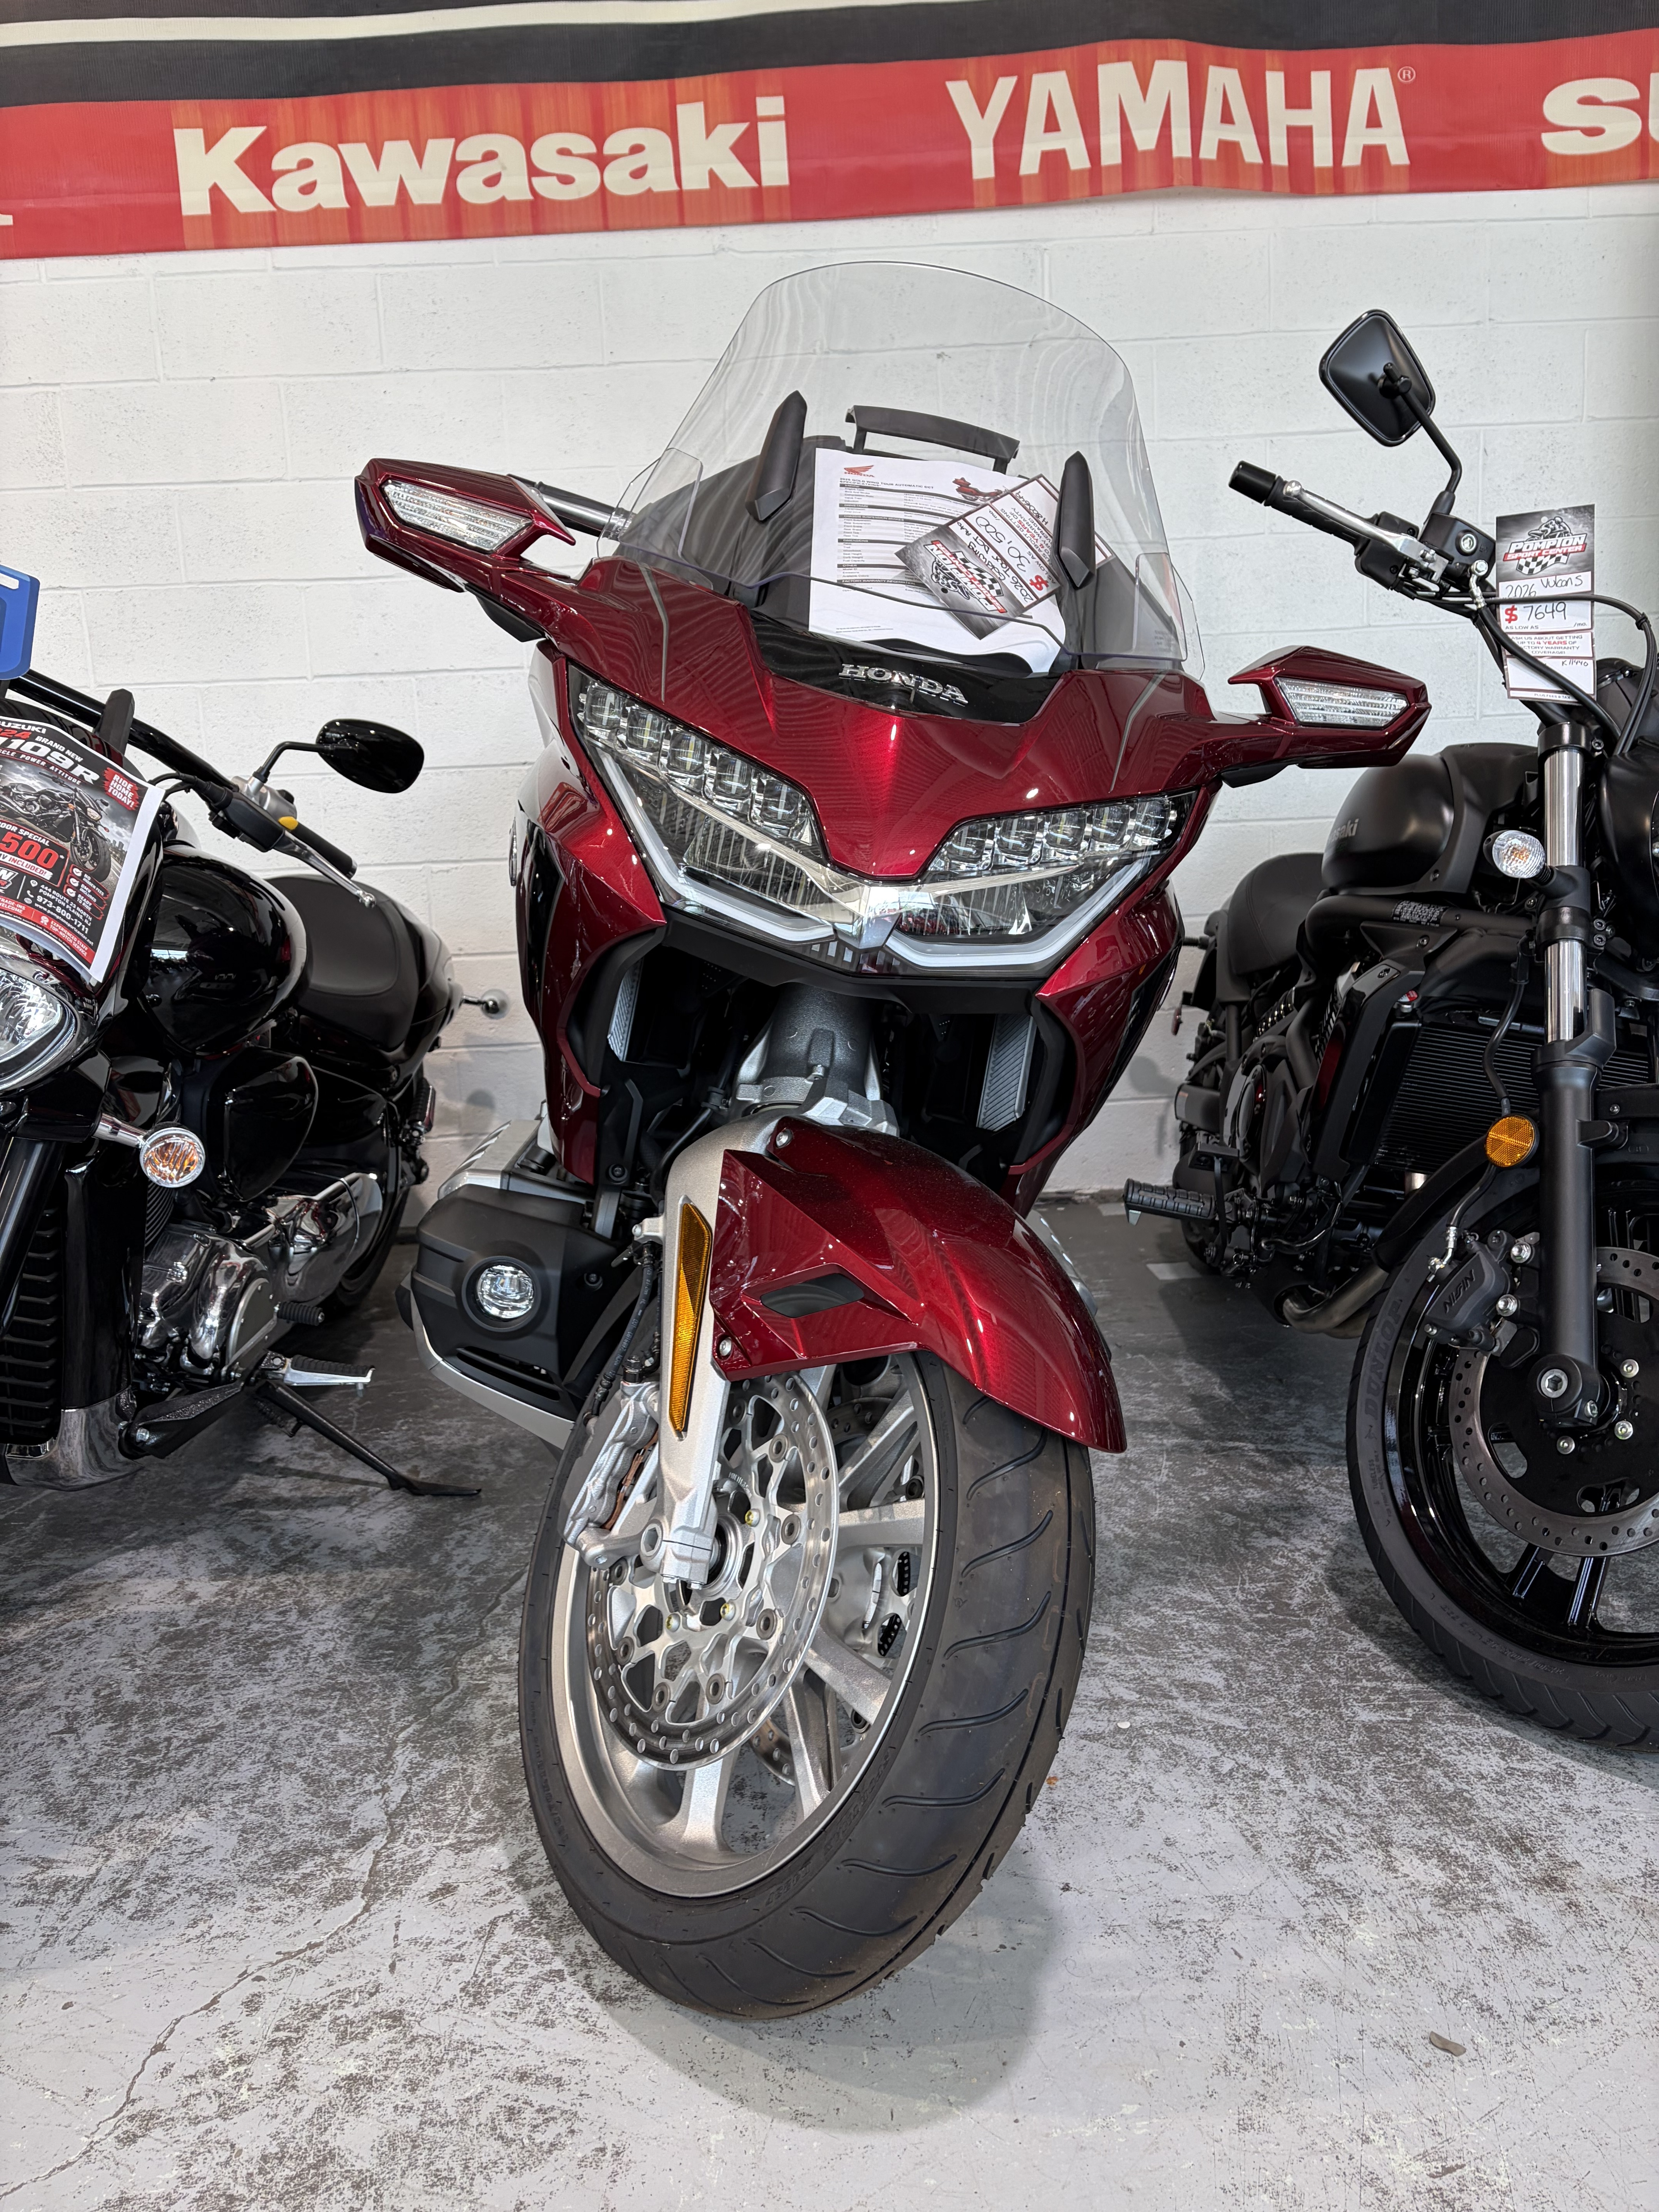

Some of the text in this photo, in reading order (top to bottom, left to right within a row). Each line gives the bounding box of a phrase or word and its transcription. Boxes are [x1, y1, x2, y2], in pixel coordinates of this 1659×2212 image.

[1541, 77, 1659, 155] S
[173, 96, 790, 217] Kawasaki
[999, 507, 1024, 534] GETTING
[1008, 510, 1018, 520] OF
[1010, 505, 1042, 540] WARRANTY
[1017, 518, 1040, 544] YEARS
[1022, 531, 1043, 553] ABOUT
[1509, 534, 1587, 553] POMPTON
[972, 536, 989, 553] DCT
[975, 516, 1050, 591] $ 30,500
[1025, 550, 1037, 562] AS
[1507, 545, 1583, 560] SPORT CENTER
[936, 540, 974, 580] CENTER
[991, 553, 1013, 577] Tour
[1034, 559, 1049, 575] LOW
[925, 543, 998, 611] POMPTON
[1010, 576, 1033, 602] 2026
[1046, 574, 1057, 585] AS
[1506, 575, 1583, 598] 2026 Vulcan S
[972, 578, 1003, 612] SPORT
[1505, 601, 1566, 623] $ 7649
[838, 663, 969, 707] HONDA
[0, 728, 32, 739] 24
[0, 737, 100, 785] 109R
[35, 736, 84, 763] BRAND NEW
[49, 765, 82, 785] ATTITUDE
[113, 774, 134, 791] RIDE
[108, 785, 135, 808] TODAY!
[110, 780, 134, 799] HOME
[18, 828, 50, 847] SPECIAL
[8, 856, 48, 876] INCLUDED!
[36, 895, 89, 934] 973-800-1711
[39, 889, 65, 907] POMPTON
[66, 904, 84, 921] PLAINS,
[40, 884, 52, 893] 444
[52, 890, 69, 904] ROUTE
[77, 906, 92, 921] NORTH
[50, 923, 73, 944] TOP-NOTCH
[72, 941, 88, 957] SERVICE
[51, 921, 77, 941] EXPERIENCED
[77, 938, 88, 950] STAFF
[1365, 1299, 1403, 1420] DUNLOP
[1368, 1458, 1379, 1490] TUBELESS
